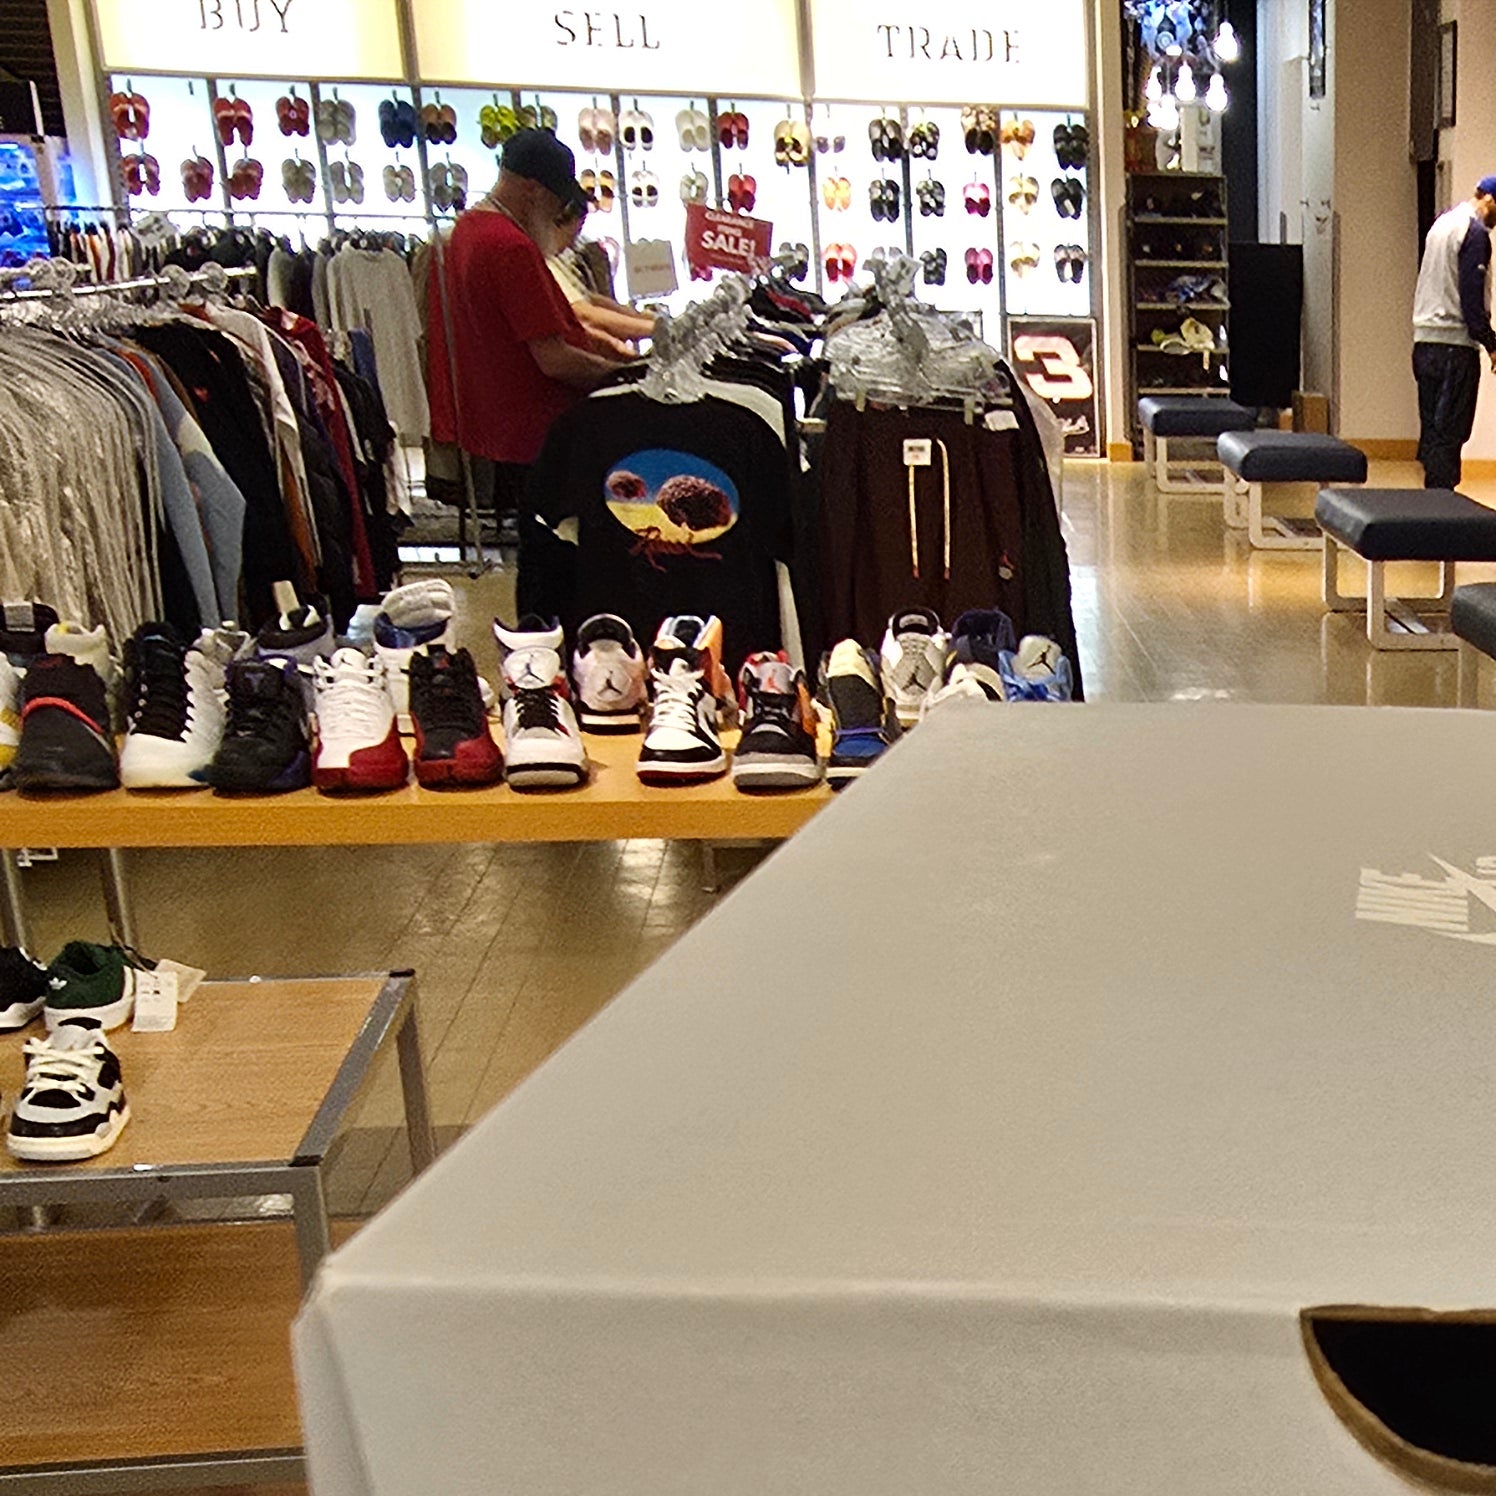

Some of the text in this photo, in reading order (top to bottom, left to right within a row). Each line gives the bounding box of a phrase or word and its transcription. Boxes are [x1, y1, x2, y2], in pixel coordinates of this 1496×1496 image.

[199, 0, 293, 33] BUY
[554, 10, 660, 50] SELL
[877, 24, 1020, 63] TRADE
[1014, 335, 1093, 400] 3
